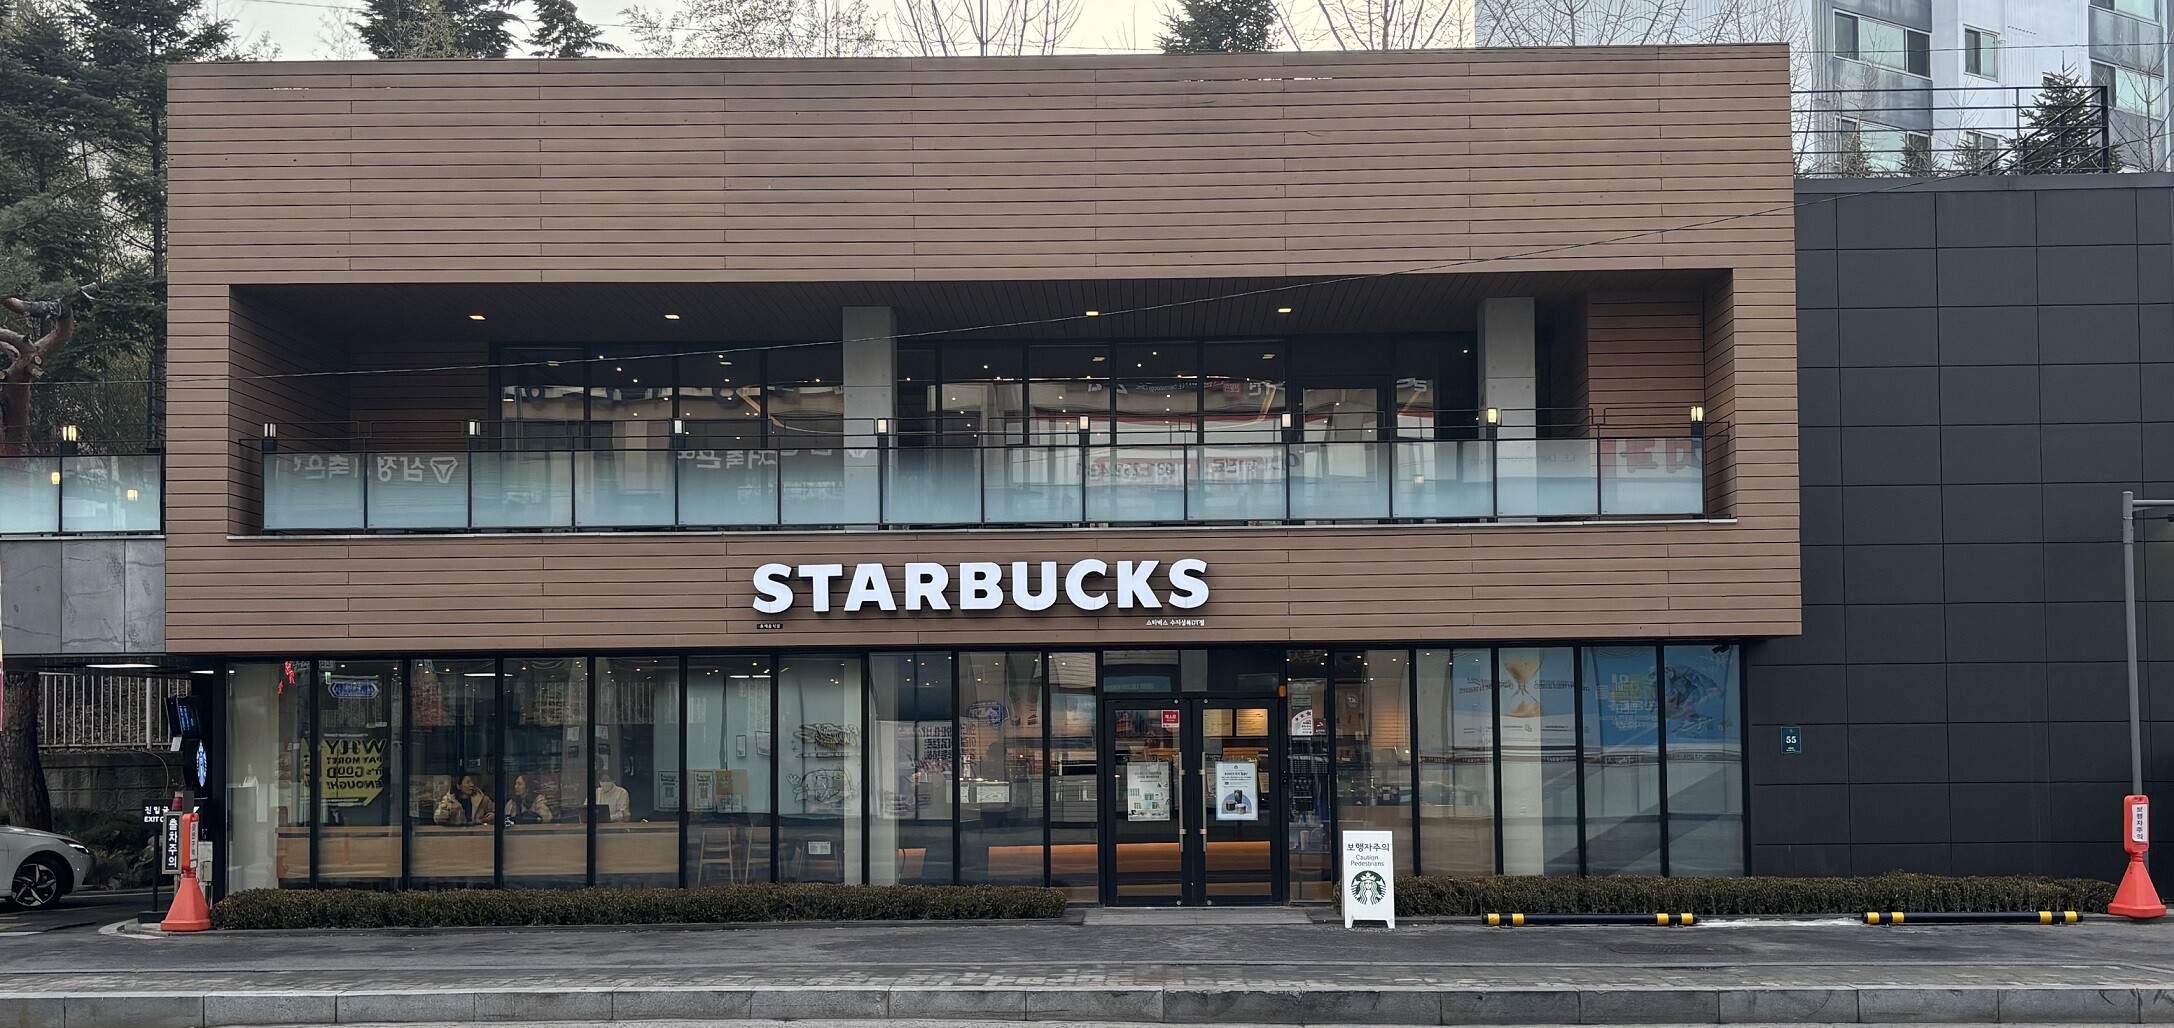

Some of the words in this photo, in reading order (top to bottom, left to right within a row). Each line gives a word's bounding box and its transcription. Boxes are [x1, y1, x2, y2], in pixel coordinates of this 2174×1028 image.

[752, 558, 1211, 614] STARBUCKS
[1785, 735, 1797, 744] 55
[2136, 806, 2144, 840] 보행자주의
[168, 818, 178, 868] 출차주의
[1346, 842, 1390, 852] 보행자주의
